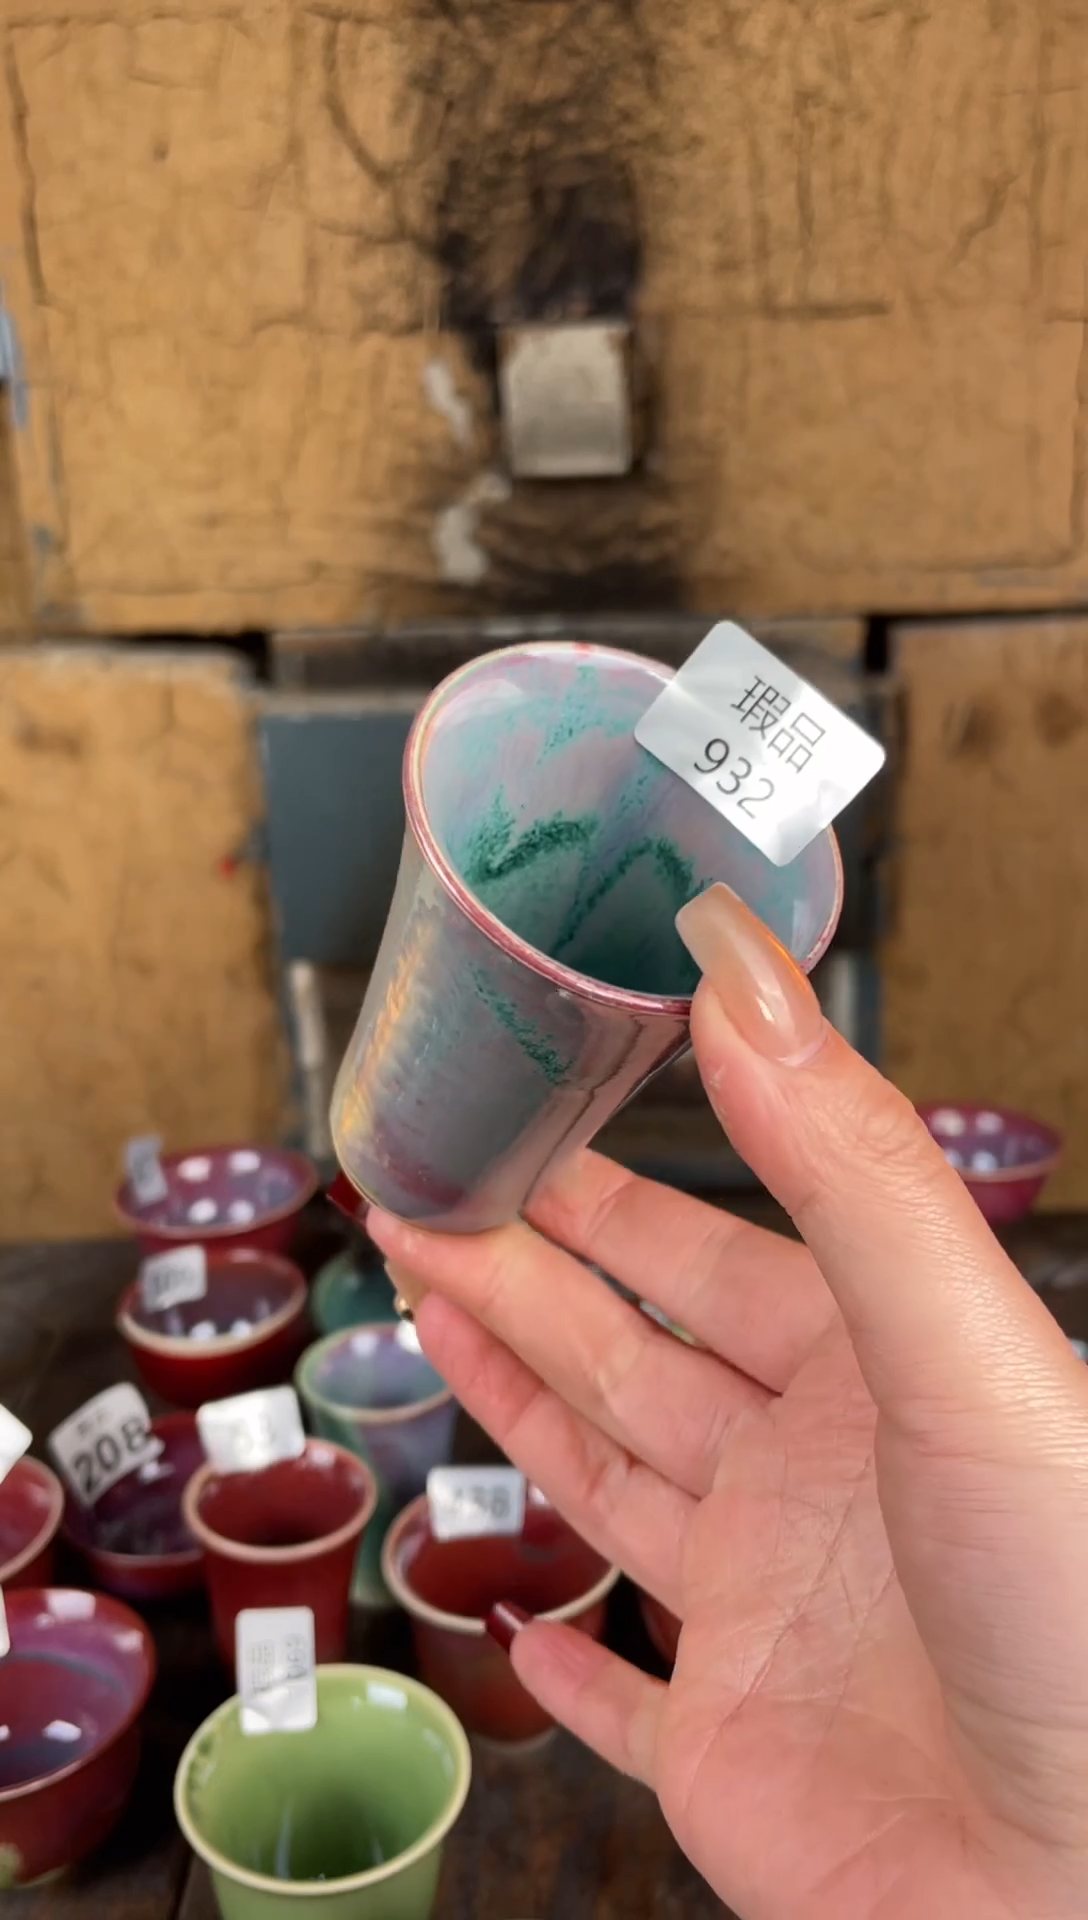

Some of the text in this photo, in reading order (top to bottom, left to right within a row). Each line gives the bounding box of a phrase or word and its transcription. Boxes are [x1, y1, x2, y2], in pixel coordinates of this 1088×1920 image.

[730, 674, 827, 774] 瑕品
[692, 737, 776, 820] 932
[74, 1416, 147, 1494] 208
